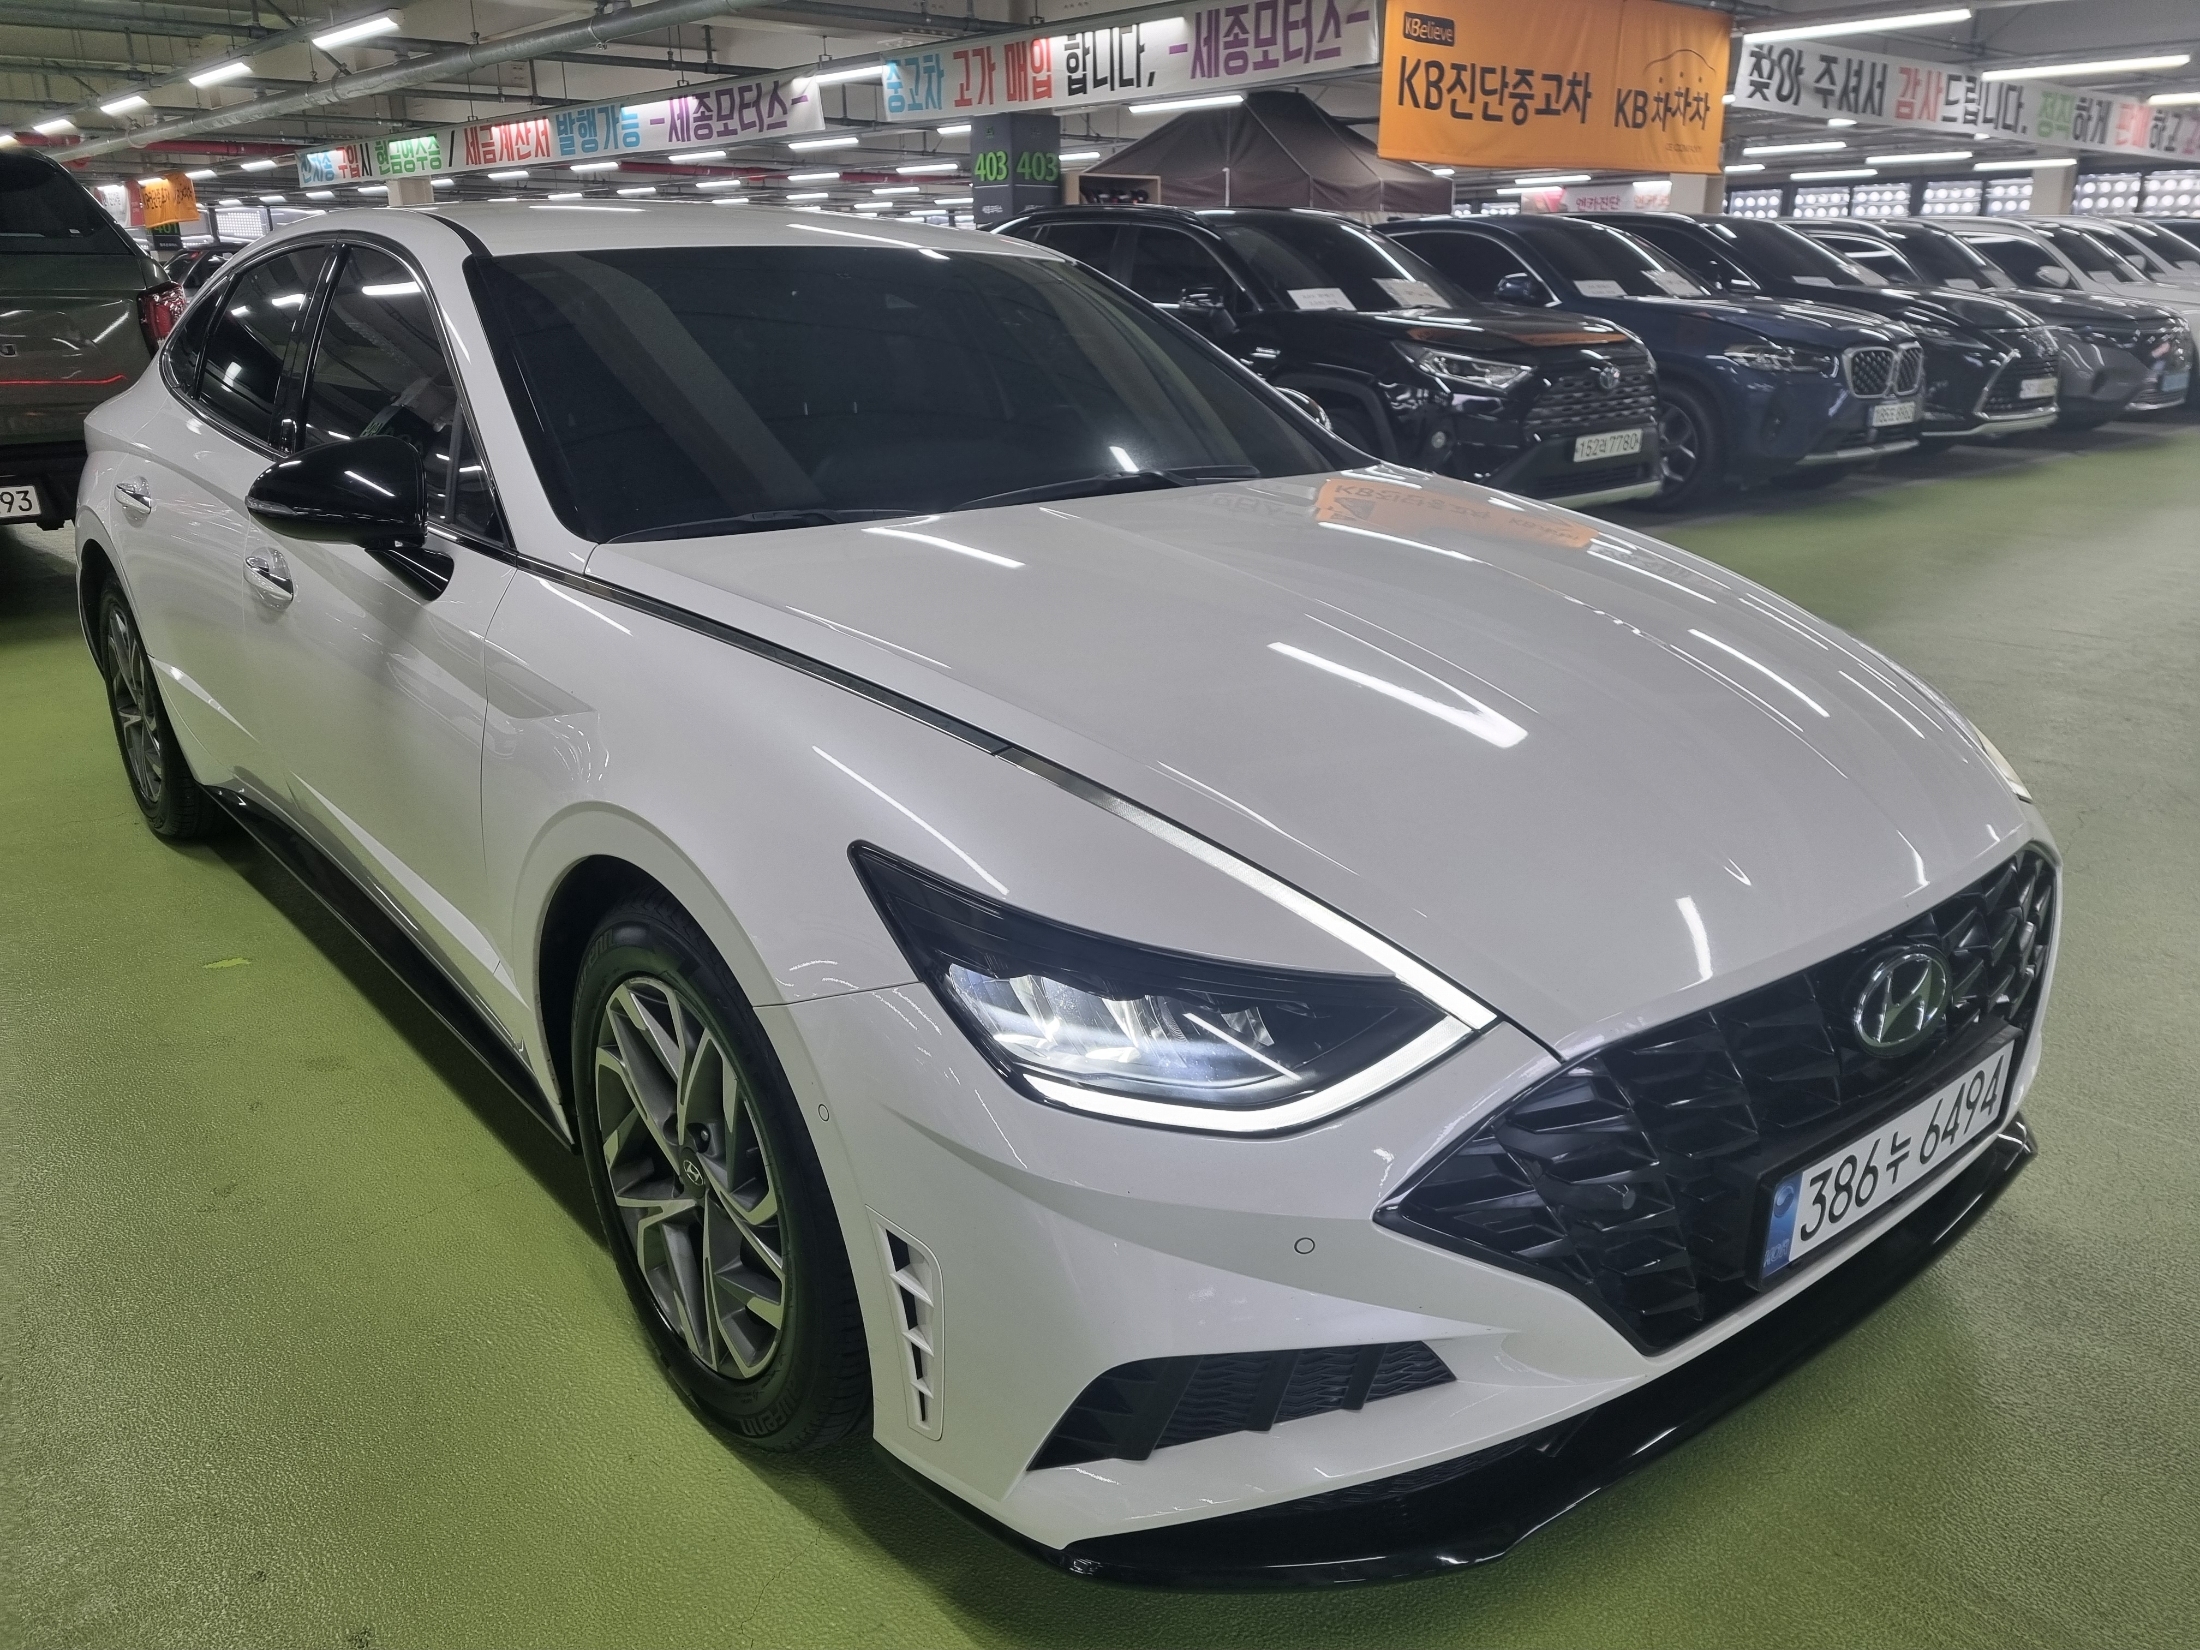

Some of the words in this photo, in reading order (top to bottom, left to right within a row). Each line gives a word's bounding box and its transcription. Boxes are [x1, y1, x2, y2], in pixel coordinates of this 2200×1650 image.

[1404, 15, 1454, 43] KBelieve
[886, 53, 944, 113] 중고차
[953, 46, 996, 107] 고가
[1003, 37, 1053, 102] 매입
[1398, 55, 1592, 126] KB진단중고차
[1747, 44, 1804, 105] 찾아
[1814, 54, 1888, 117] 주셔서
[463, 115, 551, 166] 세금계산서
[555, 104, 641, 156] 발행가능
[974, 150, 1008, 181] 403
[1016, 151, 1059, 181] 403
[1800, 1131, 1912, 1241] 386누
[1919, 1054, 2004, 1164] 6494
